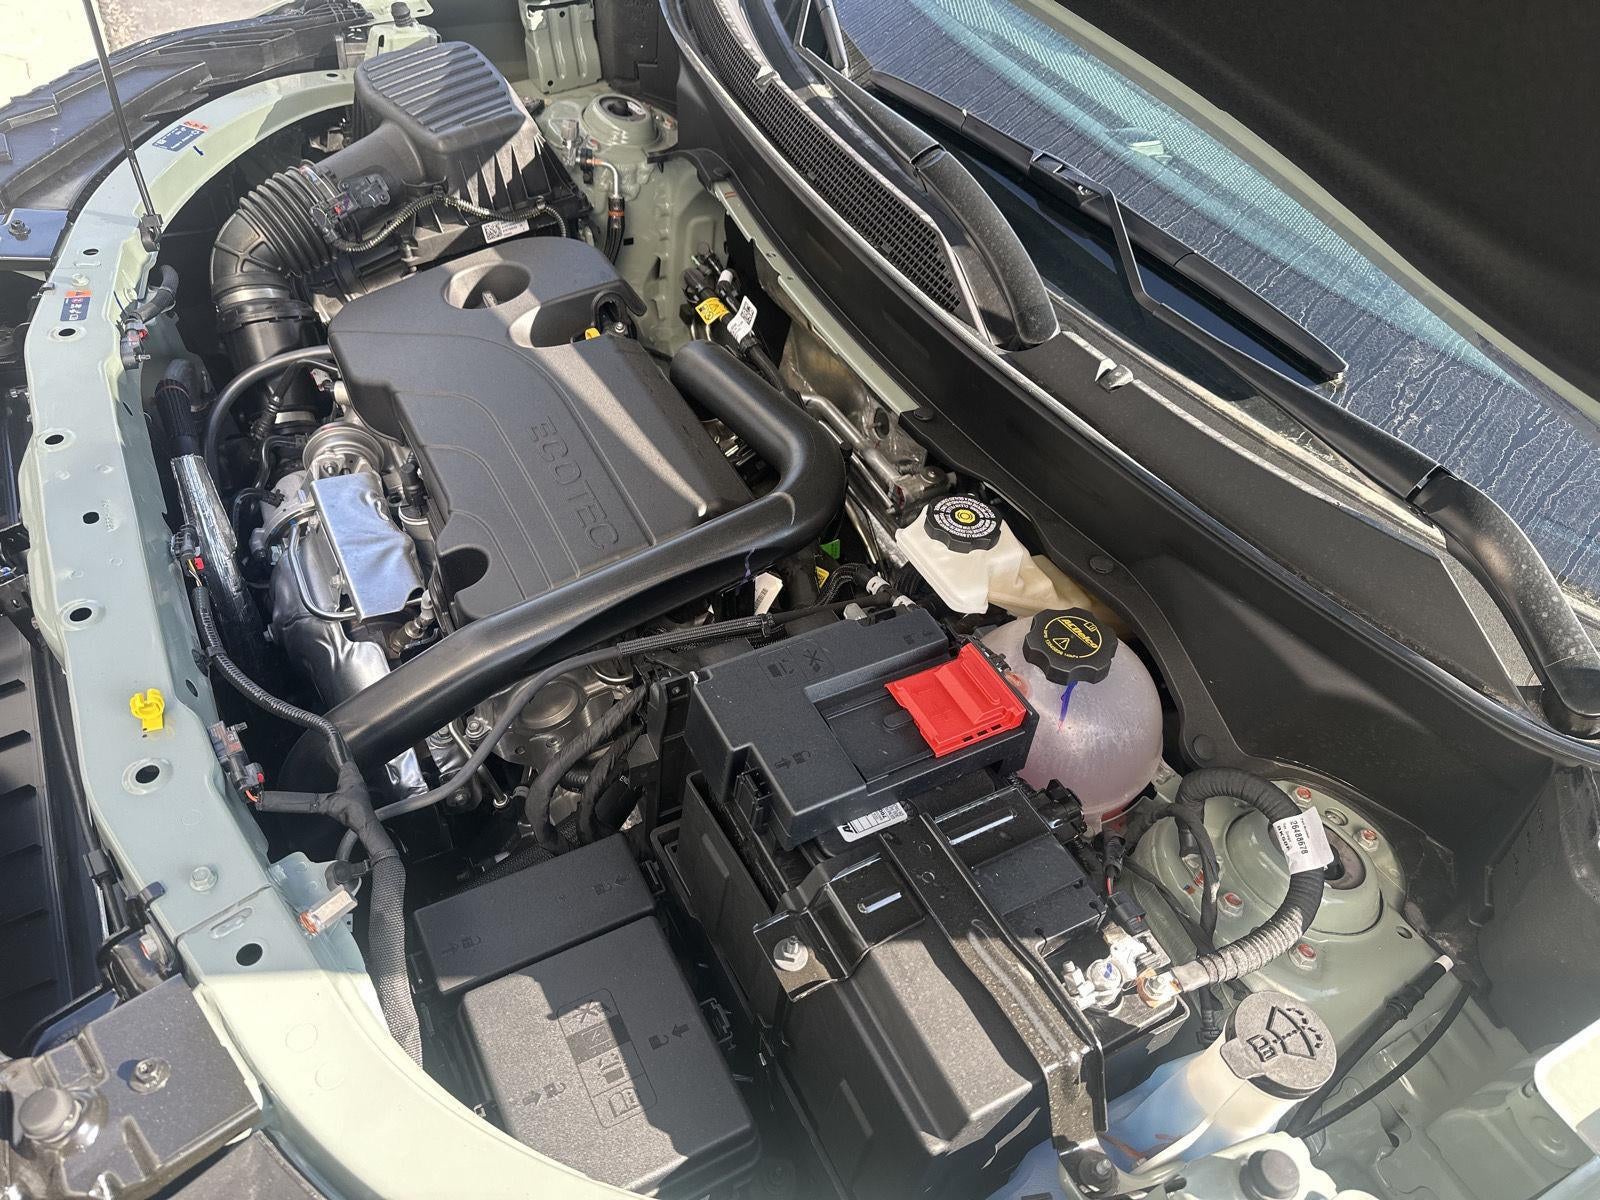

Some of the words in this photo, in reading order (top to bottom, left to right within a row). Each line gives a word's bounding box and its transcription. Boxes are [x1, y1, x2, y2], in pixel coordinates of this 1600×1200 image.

[530, 415, 620, 551] ECOTEC
[1060, 619, 1099, 649] ACDelco
[1290, 820, 1309, 855] 26488678
